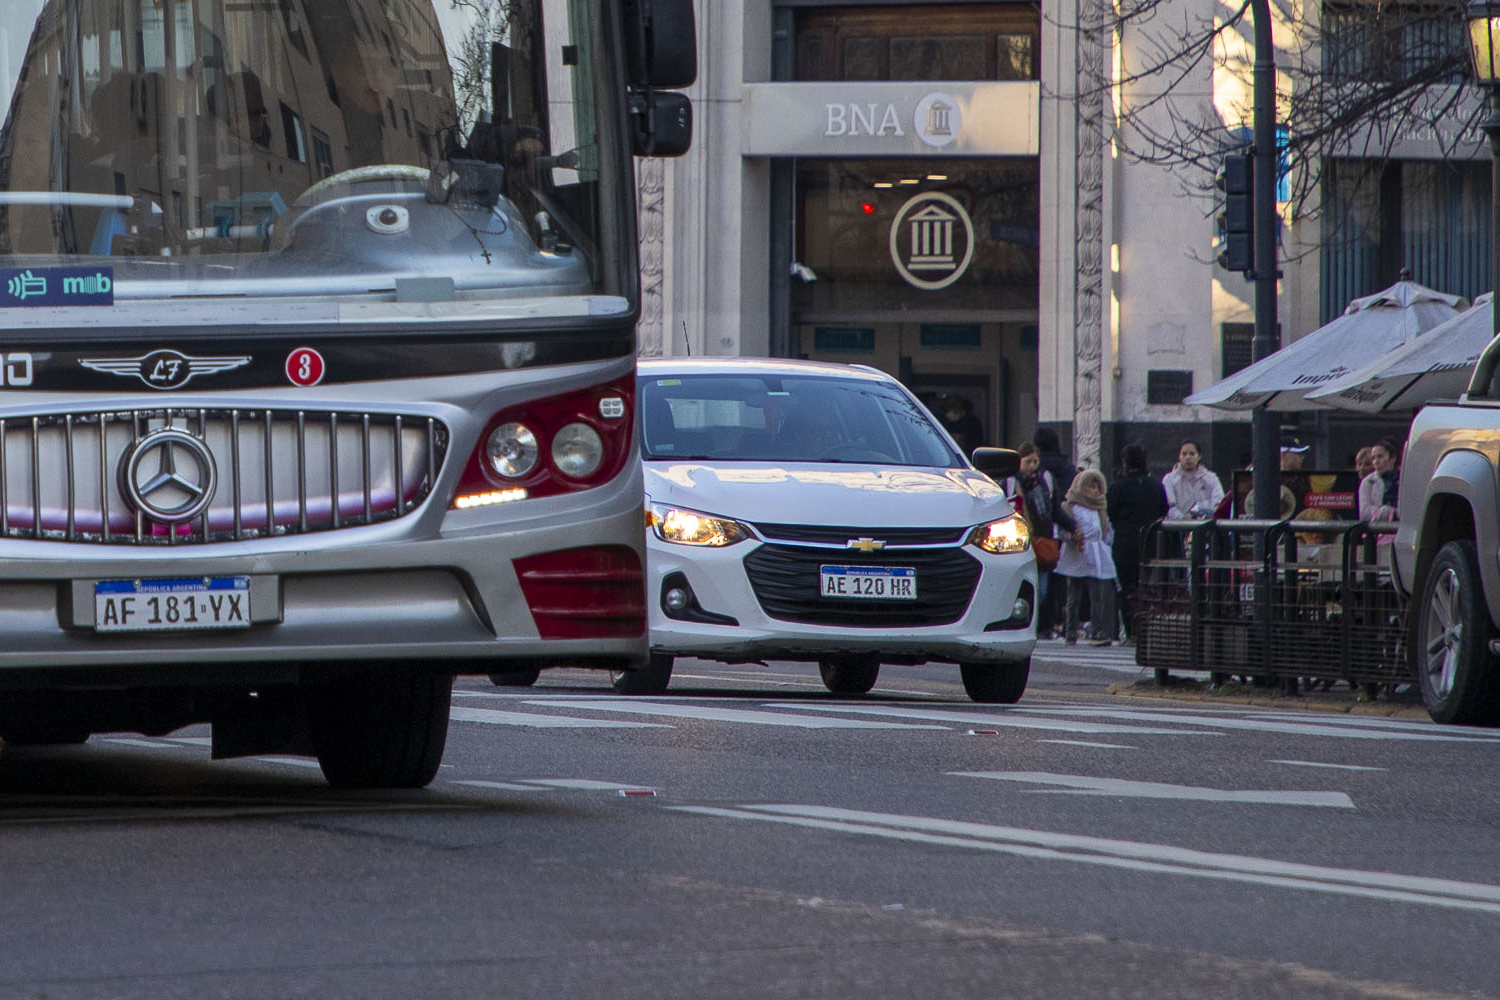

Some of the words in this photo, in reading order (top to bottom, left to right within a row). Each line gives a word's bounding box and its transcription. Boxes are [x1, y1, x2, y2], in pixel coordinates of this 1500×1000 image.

[824, 103, 905, 137] BNA
[298, 353, 312, 380] 3
[827, 576, 847, 594] AE
[852, 577, 885, 595] 120
[890, 578, 912, 596] HR
[103, 597, 136, 625] AF
[146, 595, 198, 624] 181
[209, 593, 243, 622] YX
